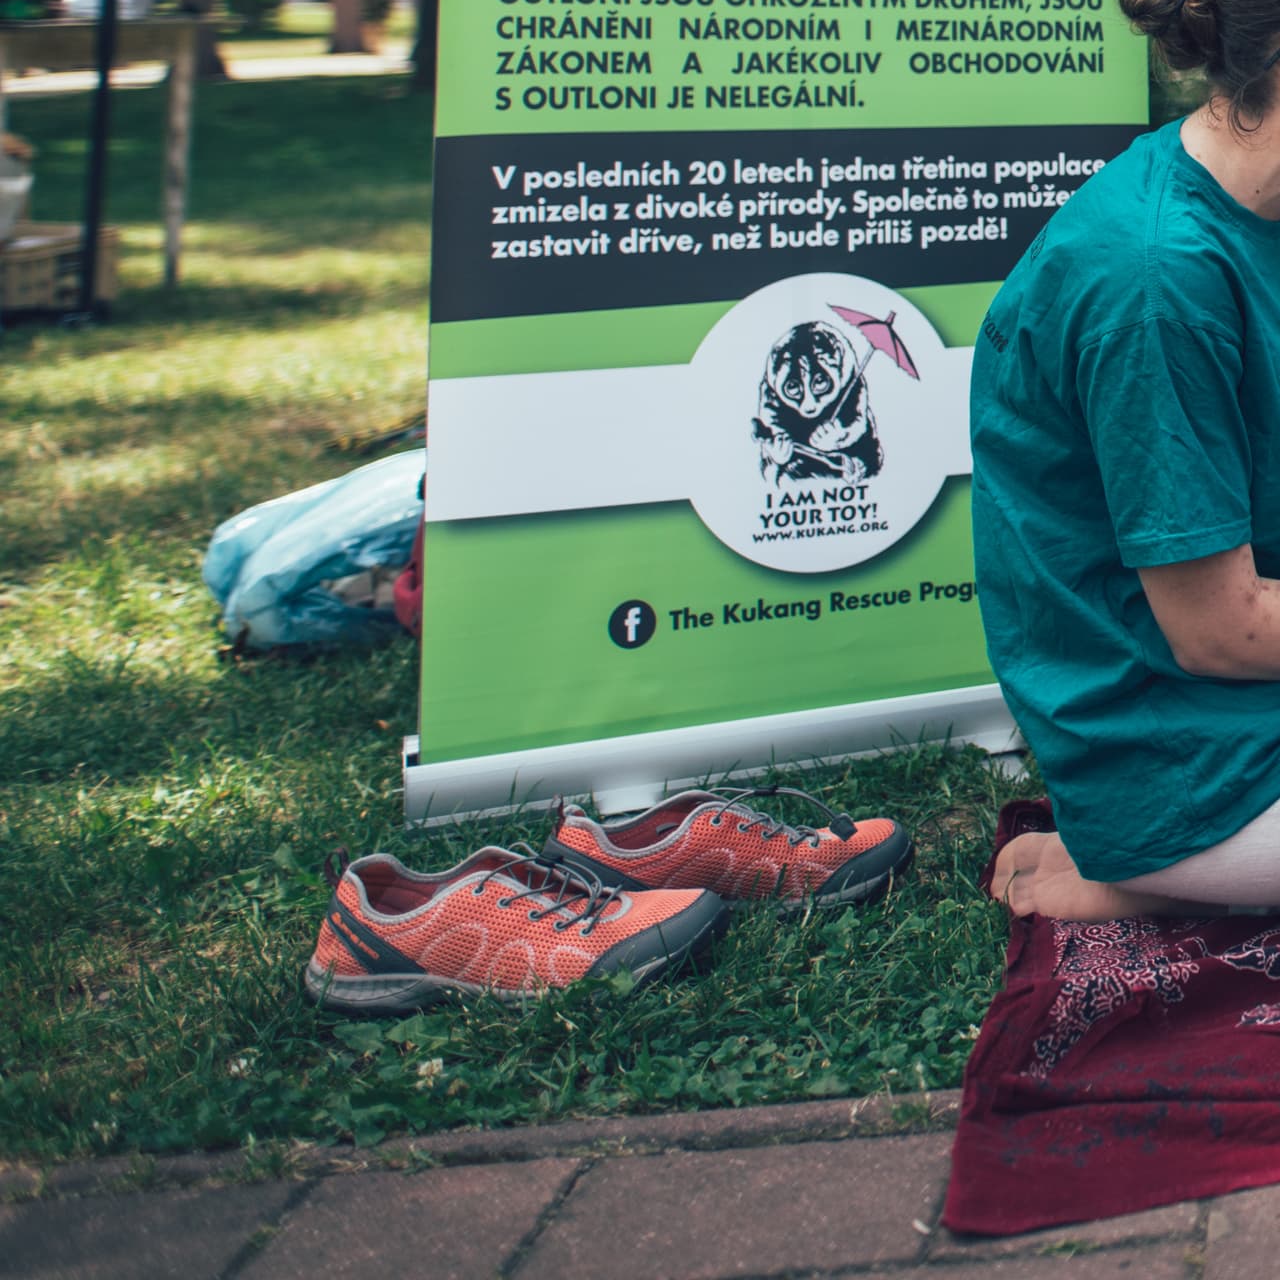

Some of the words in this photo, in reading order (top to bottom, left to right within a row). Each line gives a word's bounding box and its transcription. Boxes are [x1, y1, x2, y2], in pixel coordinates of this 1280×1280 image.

[497, 10, 651, 39] CHRÁNĚNI
[680, 12, 840, 40] NÁRODNÍM
[866, 20, 871, 40] I
[896, 15, 1104, 42] MEZINÁRODNÍM
[496, 45, 651, 74] ZÁKONEM
[682, 52, 702, 74] A
[732, 46, 882, 74] JAKÉKOLIV
[909, 47, 1103, 74] OBCHODOVÁNÍ
[496, 87, 511, 110] S
[523, 86, 656, 110] OUTLONI
[667, 86, 694, 109] JE
[706, 80, 864, 108] NELEGÁLNÍ.
[492, 166, 516, 189] V
[524, 160, 680, 197] posledních
[689, 161, 726, 185] 20
[734, 158, 813, 184] letech
[821, 157, 895, 188] jedna
[903, 156, 987, 179] třetina
[492, 198, 606, 225] zmizela
[614, 203, 629, 220] z
[636, 193, 733, 219] divoké
[739, 189, 846, 223] přírody.
[853, 187, 968, 219] Společně
[973, 190, 998, 209] to
[1003, 184, 1076, 209] může
[492, 230, 610, 258] zastavit
[619, 226, 702, 257] dříve,
[713, 225, 761, 250] než
[771, 222, 839, 248] bude
[848, 220, 912, 252] příliš
[921, 216, 1007, 249] pozdě!
[767, 494, 772, 509] I
[780, 491, 816, 507] AM
[823, 485, 869, 503] NOT
[760, 509, 822, 528] YOUR
[828, 503, 877, 522] TOY!
[752, 521, 889, 542] WWW.KUKANG.ORG
[669, 607, 714, 630] The
[724, 599, 821, 624] Kukang
[830, 590, 911, 612] Rescue
